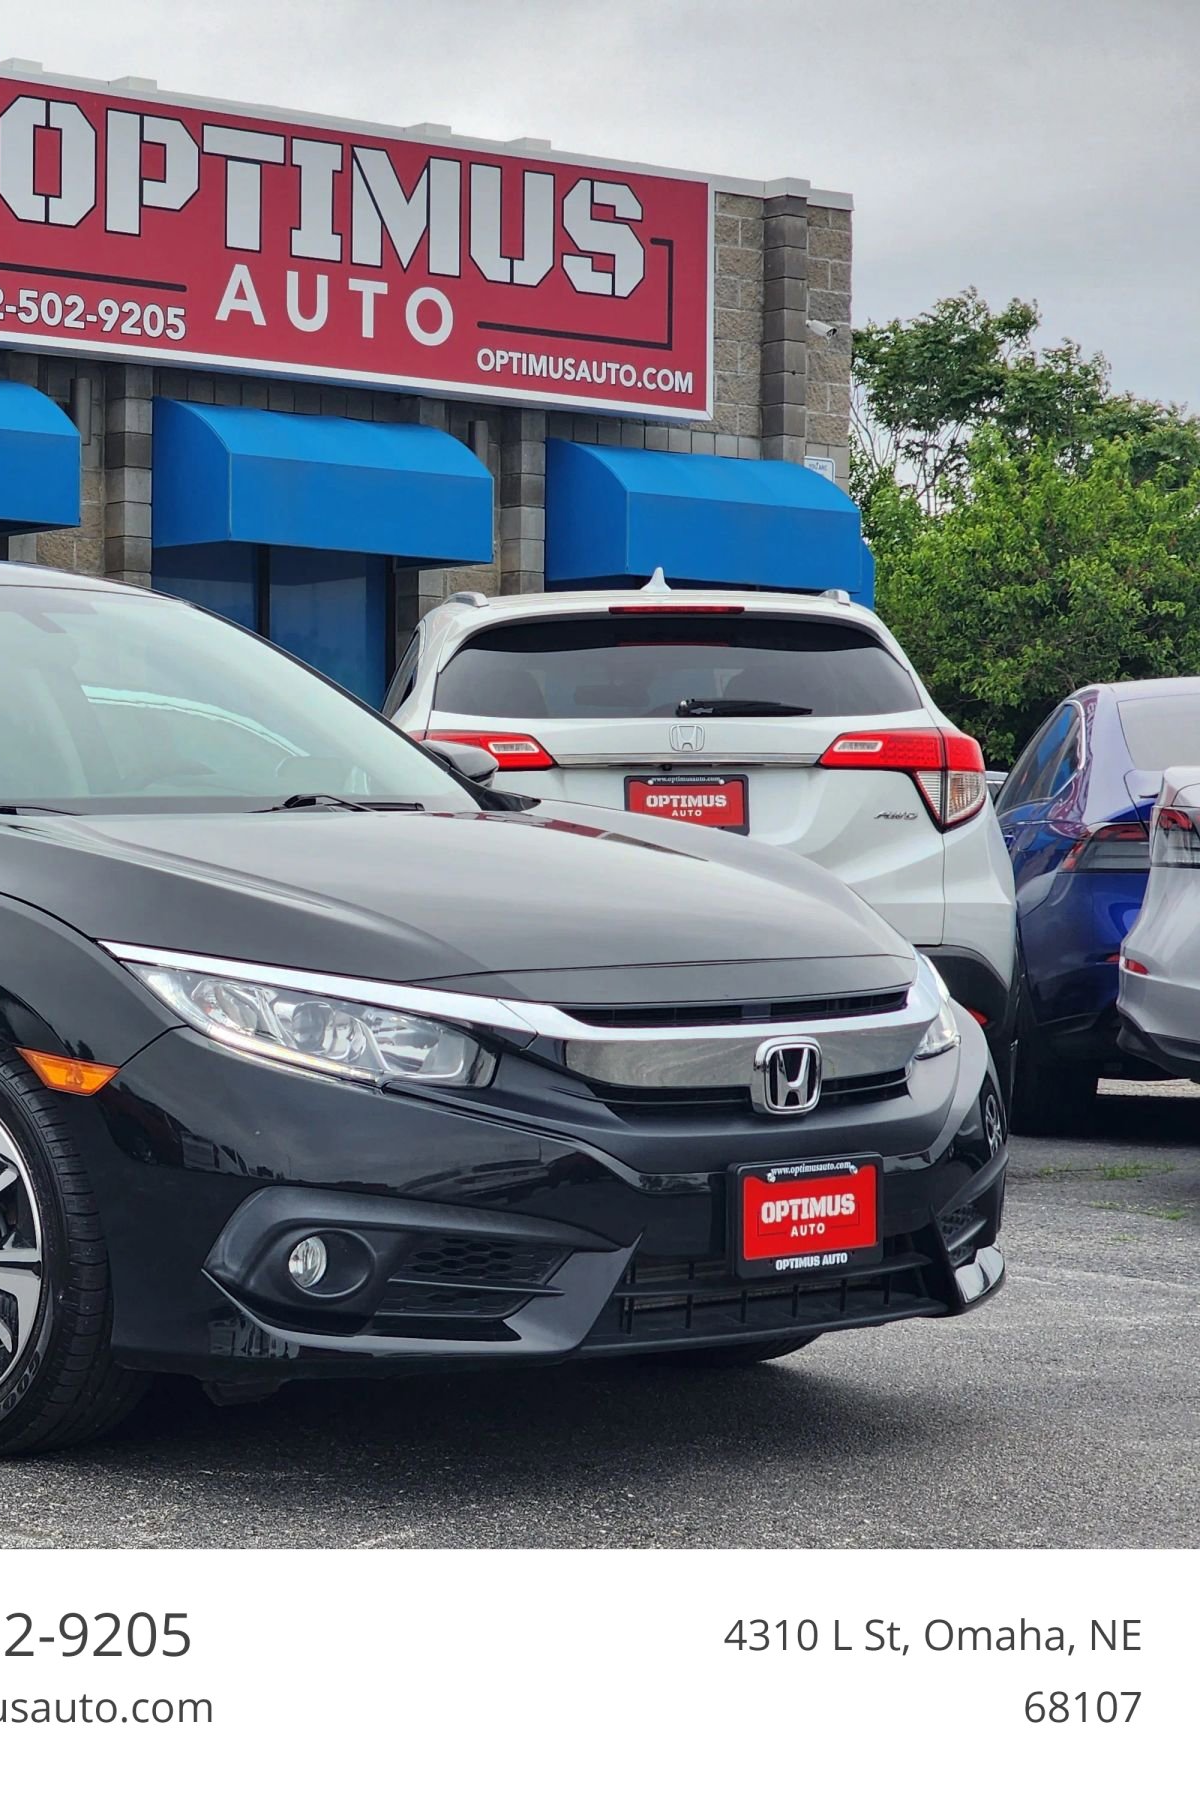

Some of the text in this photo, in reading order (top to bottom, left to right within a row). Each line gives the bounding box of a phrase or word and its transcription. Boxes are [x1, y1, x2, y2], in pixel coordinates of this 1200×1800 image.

[215, 263, 454, 347] AUTO
[476, 347, 694, 395] OPTIMUSAUTO.COM
[646, 795, 727, 808] OPTIMUS
[672, 809, 702, 817] AUTO
[771, 1161, 852, 1177] www.optimusauto.com
[761, 1192, 856, 1225] OPTIMUS
[790, 1222, 826, 1238] AUTO
[775, 1252, 848, 1271] OPTIMUS AUTO
